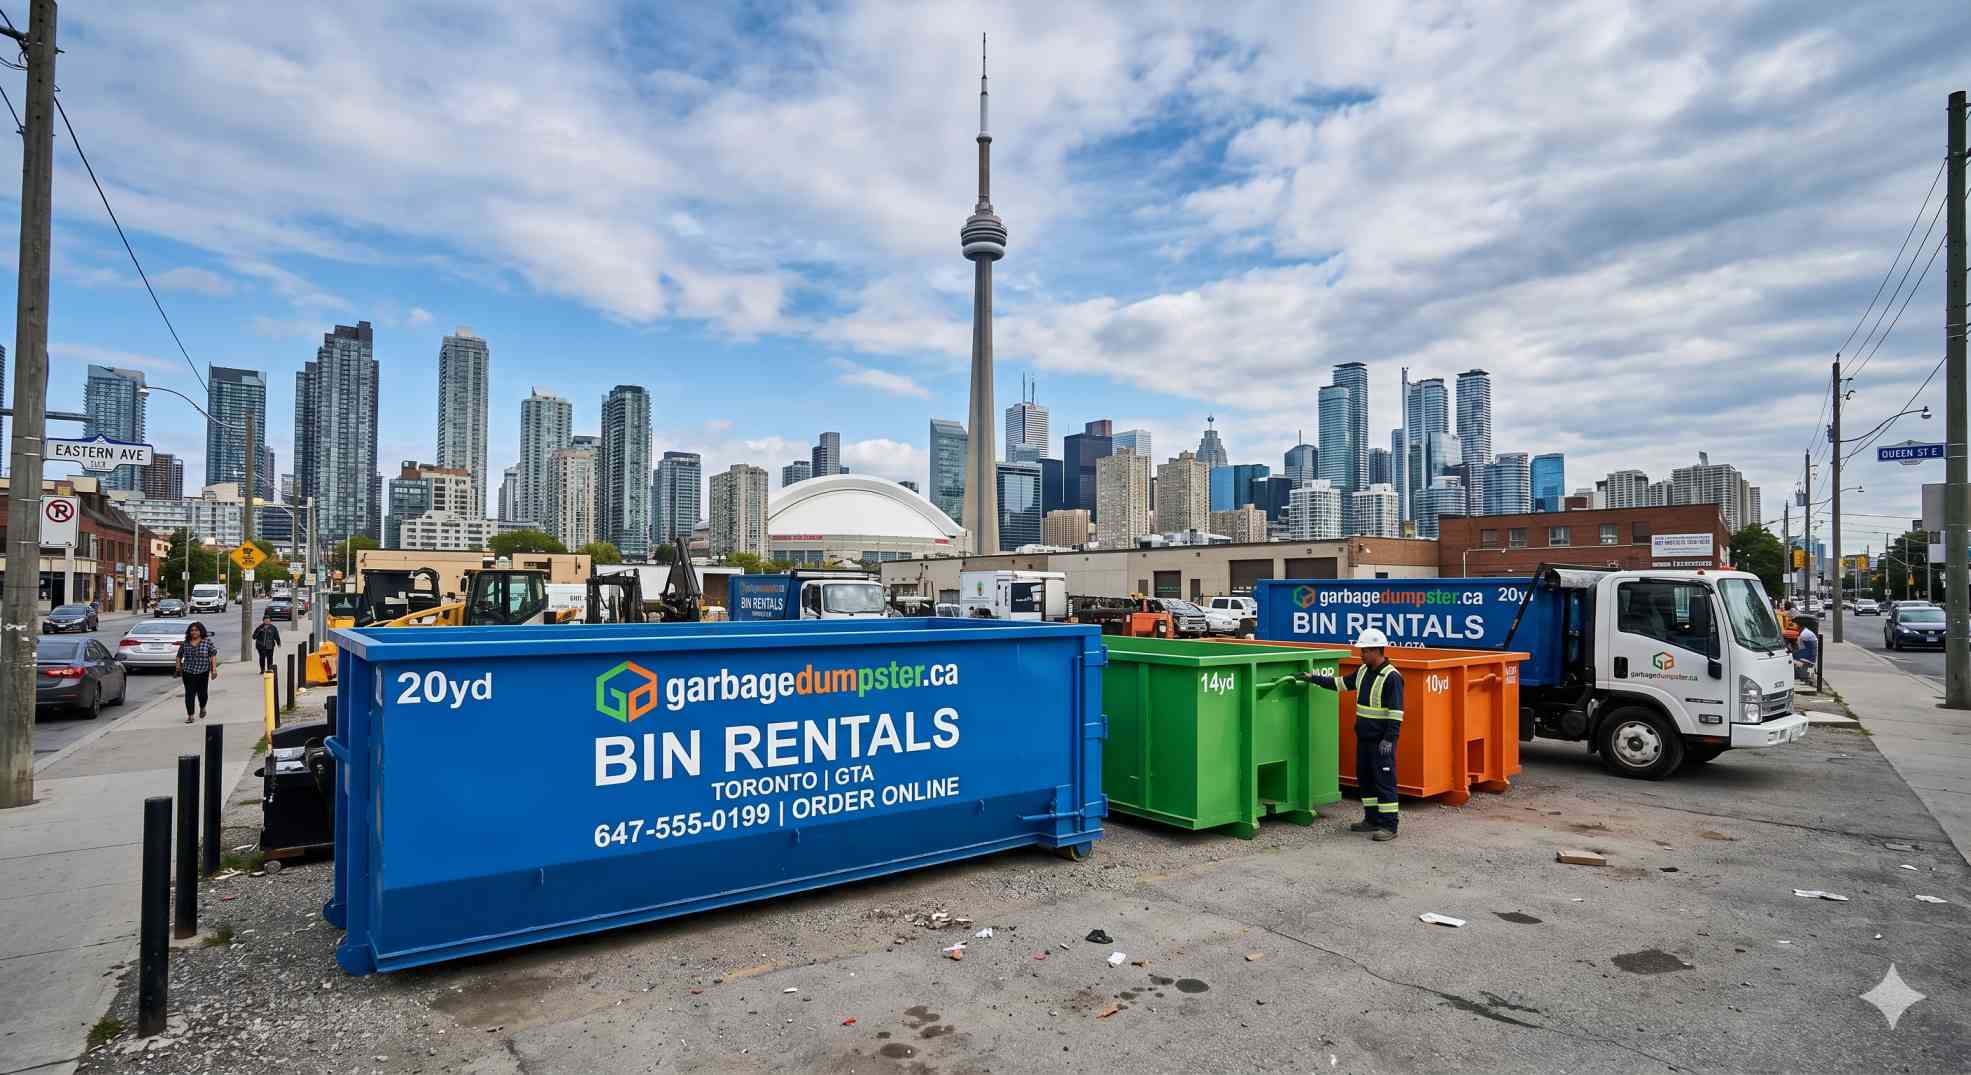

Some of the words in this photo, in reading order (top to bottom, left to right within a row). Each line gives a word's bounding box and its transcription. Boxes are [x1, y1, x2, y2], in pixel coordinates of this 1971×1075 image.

[55, 444, 114, 459] EASTERN
[119, 448, 144, 461] AVE
[1881, 448, 1913, 459] QUEEN
[1917, 448, 1929, 457] ST
[1931, 448, 1938, 456] E
[741, 597, 752, 609] BIN
[752, 597, 783, 610] RENTALS
[1320, 588, 1483, 607] garbagedumpster.ca
[1498, 587, 1534, 605] 20y
[1293, 612, 1337, 635] BIN
[1346, 613, 1485, 640] RENTALS
[397, 670, 492, 709] 20yd
[665, 661, 959, 711] garbagedumpster.ca
[1200, 671, 1235, 696] 14yd
[1425, 674, 1449, 694] 10yd
[595, 729, 701, 786] BIN
[724, 707, 960, 773] RENTALS
[711, 771, 818, 801] TORONTO
[834, 764, 875, 785] GTA
[594, 803, 770, 848] 647-555-0199
[792, 788, 876, 820] ORDER
[882, 776, 960, 806] ONLINE
